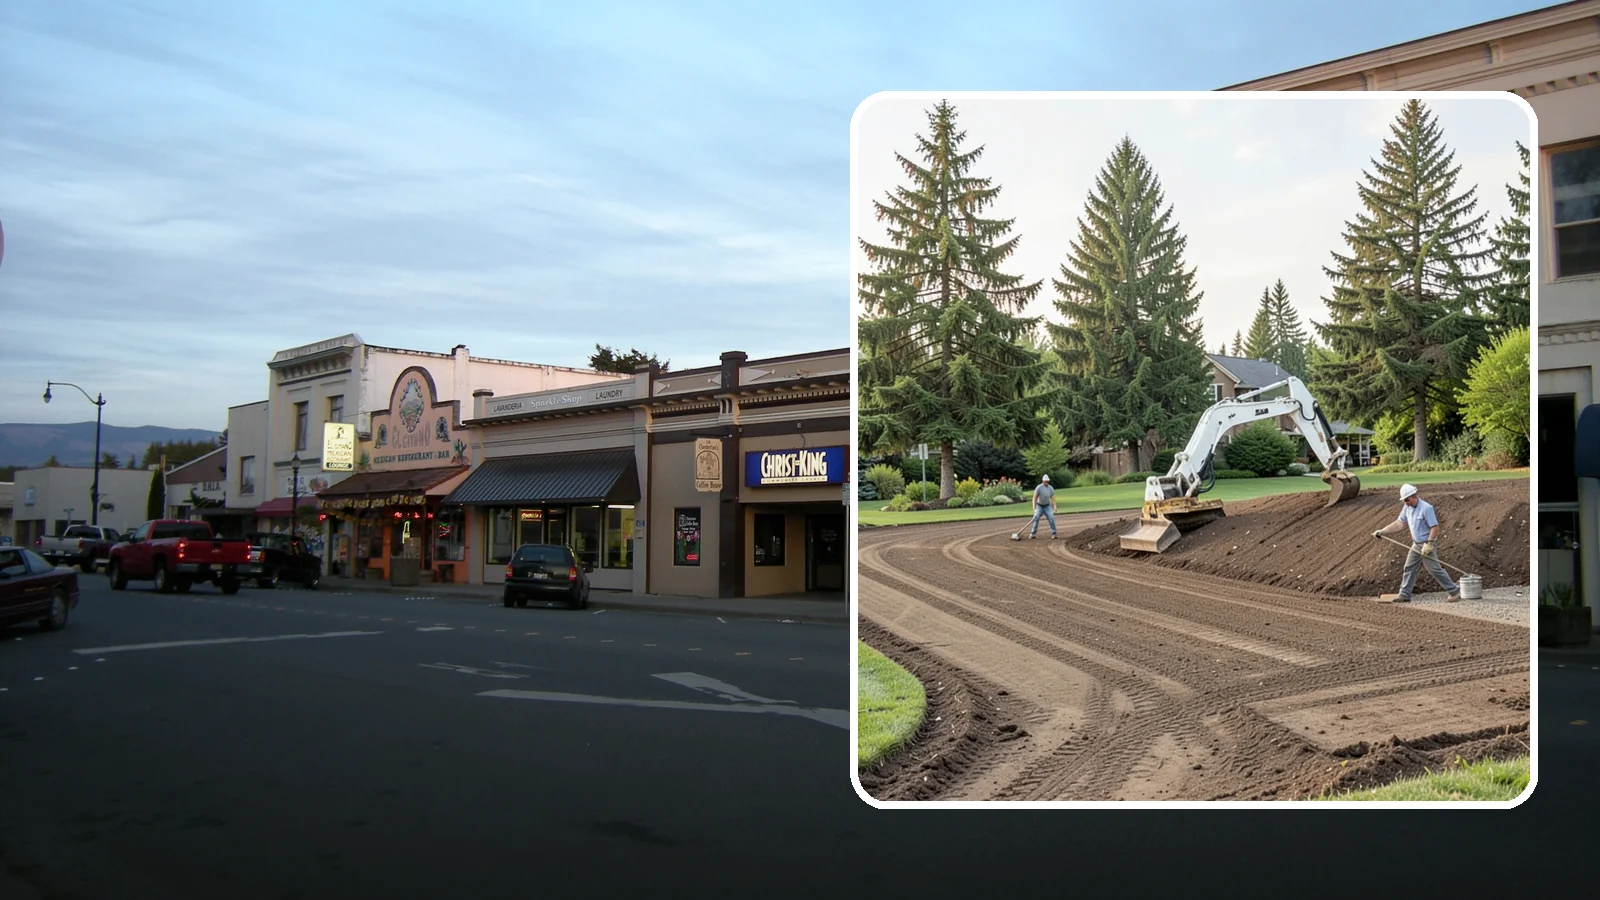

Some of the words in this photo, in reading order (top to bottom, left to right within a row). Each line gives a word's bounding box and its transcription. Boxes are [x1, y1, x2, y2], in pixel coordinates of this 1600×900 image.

[493, 402, 522, 412] LAVANDERIA
[562, 394, 582, 405] Shop
[595, 388, 623, 400] LAUNDRY
[373, 455, 396, 464] MEXICAN
[397, 451, 433, 462] RESTAURANT
[437, 450, 450, 459] BAR
[761, 452, 797, 478] CHRIST
[799, 450, 827, 476] KING
[696, 480, 709, 489] Coffee
